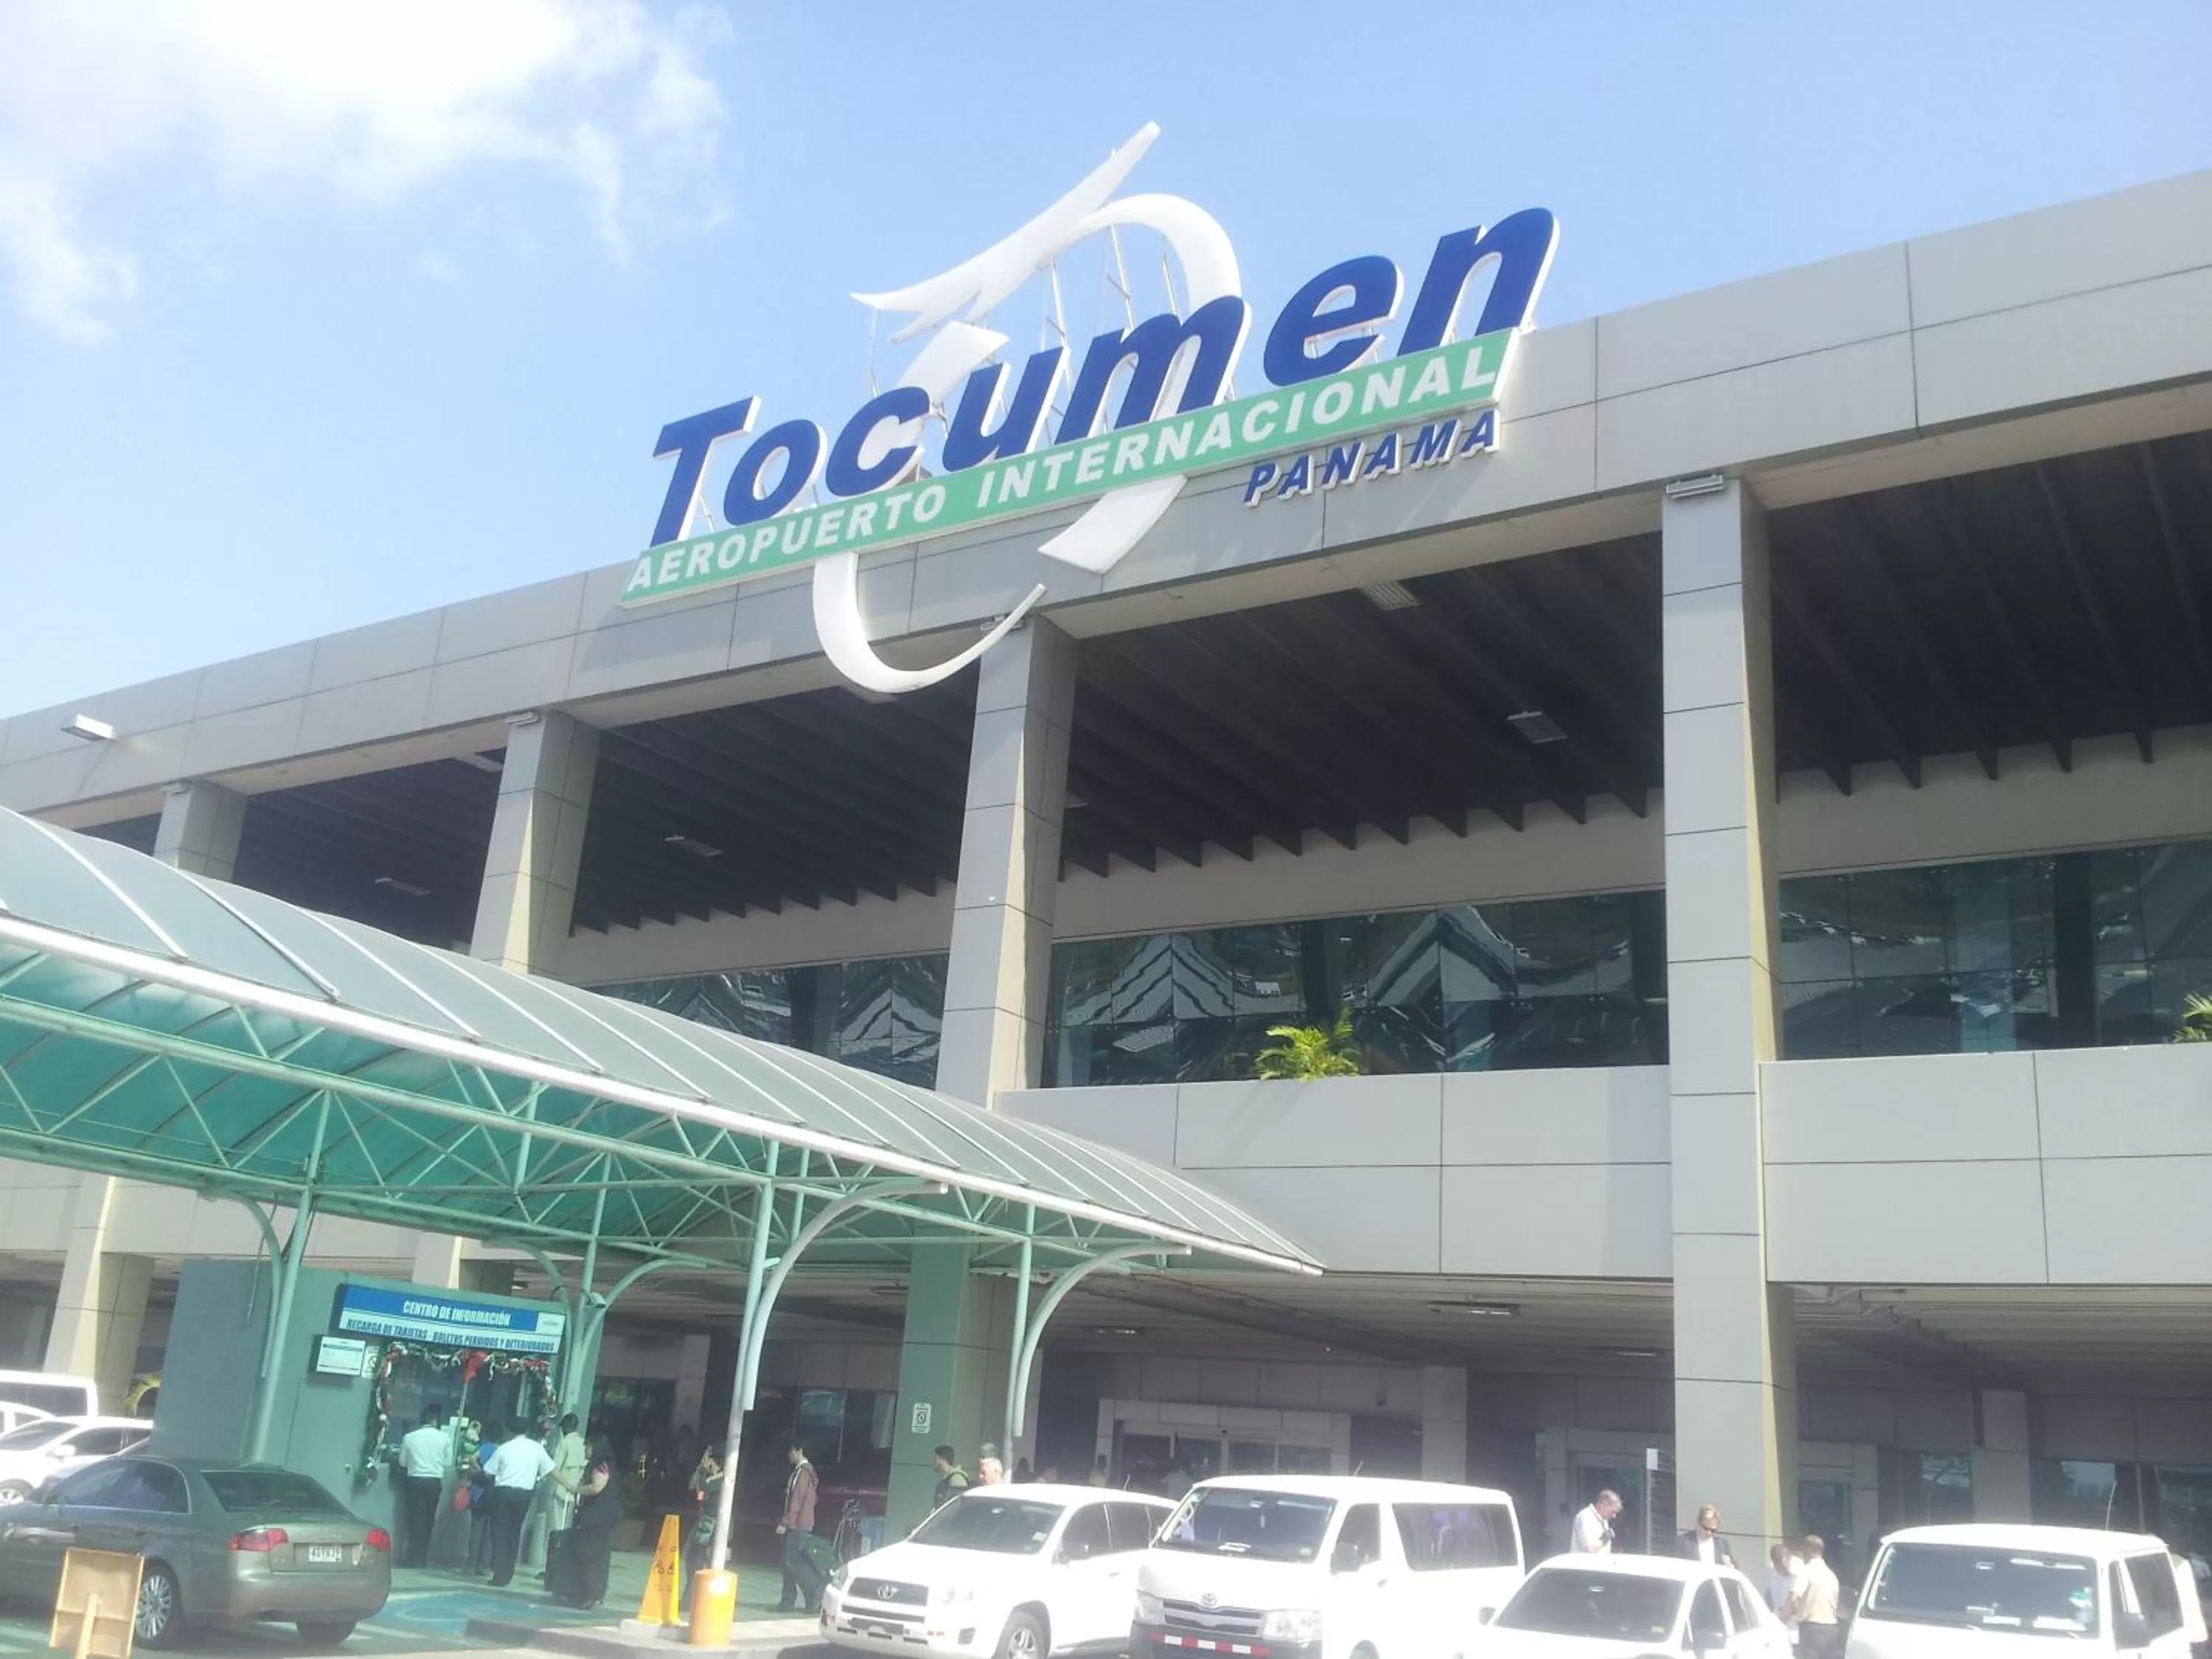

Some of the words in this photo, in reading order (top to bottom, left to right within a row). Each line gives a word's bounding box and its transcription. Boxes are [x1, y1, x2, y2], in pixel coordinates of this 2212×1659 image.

[649, 207, 1559, 549] Tocumen
[625, 484, 946, 593] AEROPUERTO
[976, 346, 1498, 509] INTERNACIONAL
[1243, 408, 1500, 507] PANAMA
[347, 1318, 381, 1332] RECARGA
[383, 1324, 392, 1334] DE
[394, 1325, 428, 1339] TARJETAS
[433, 1331, 463, 1344] BOLETOS
[465, 1335, 499, 1347] PERDIDOS
[505, 1338, 554, 1352] DETERIORADOS
[403, 1300, 438, 1318] CENTRO
[439, 1306, 451, 1319] DE
[452, 1308, 511, 1326] INFORMACIÓN
